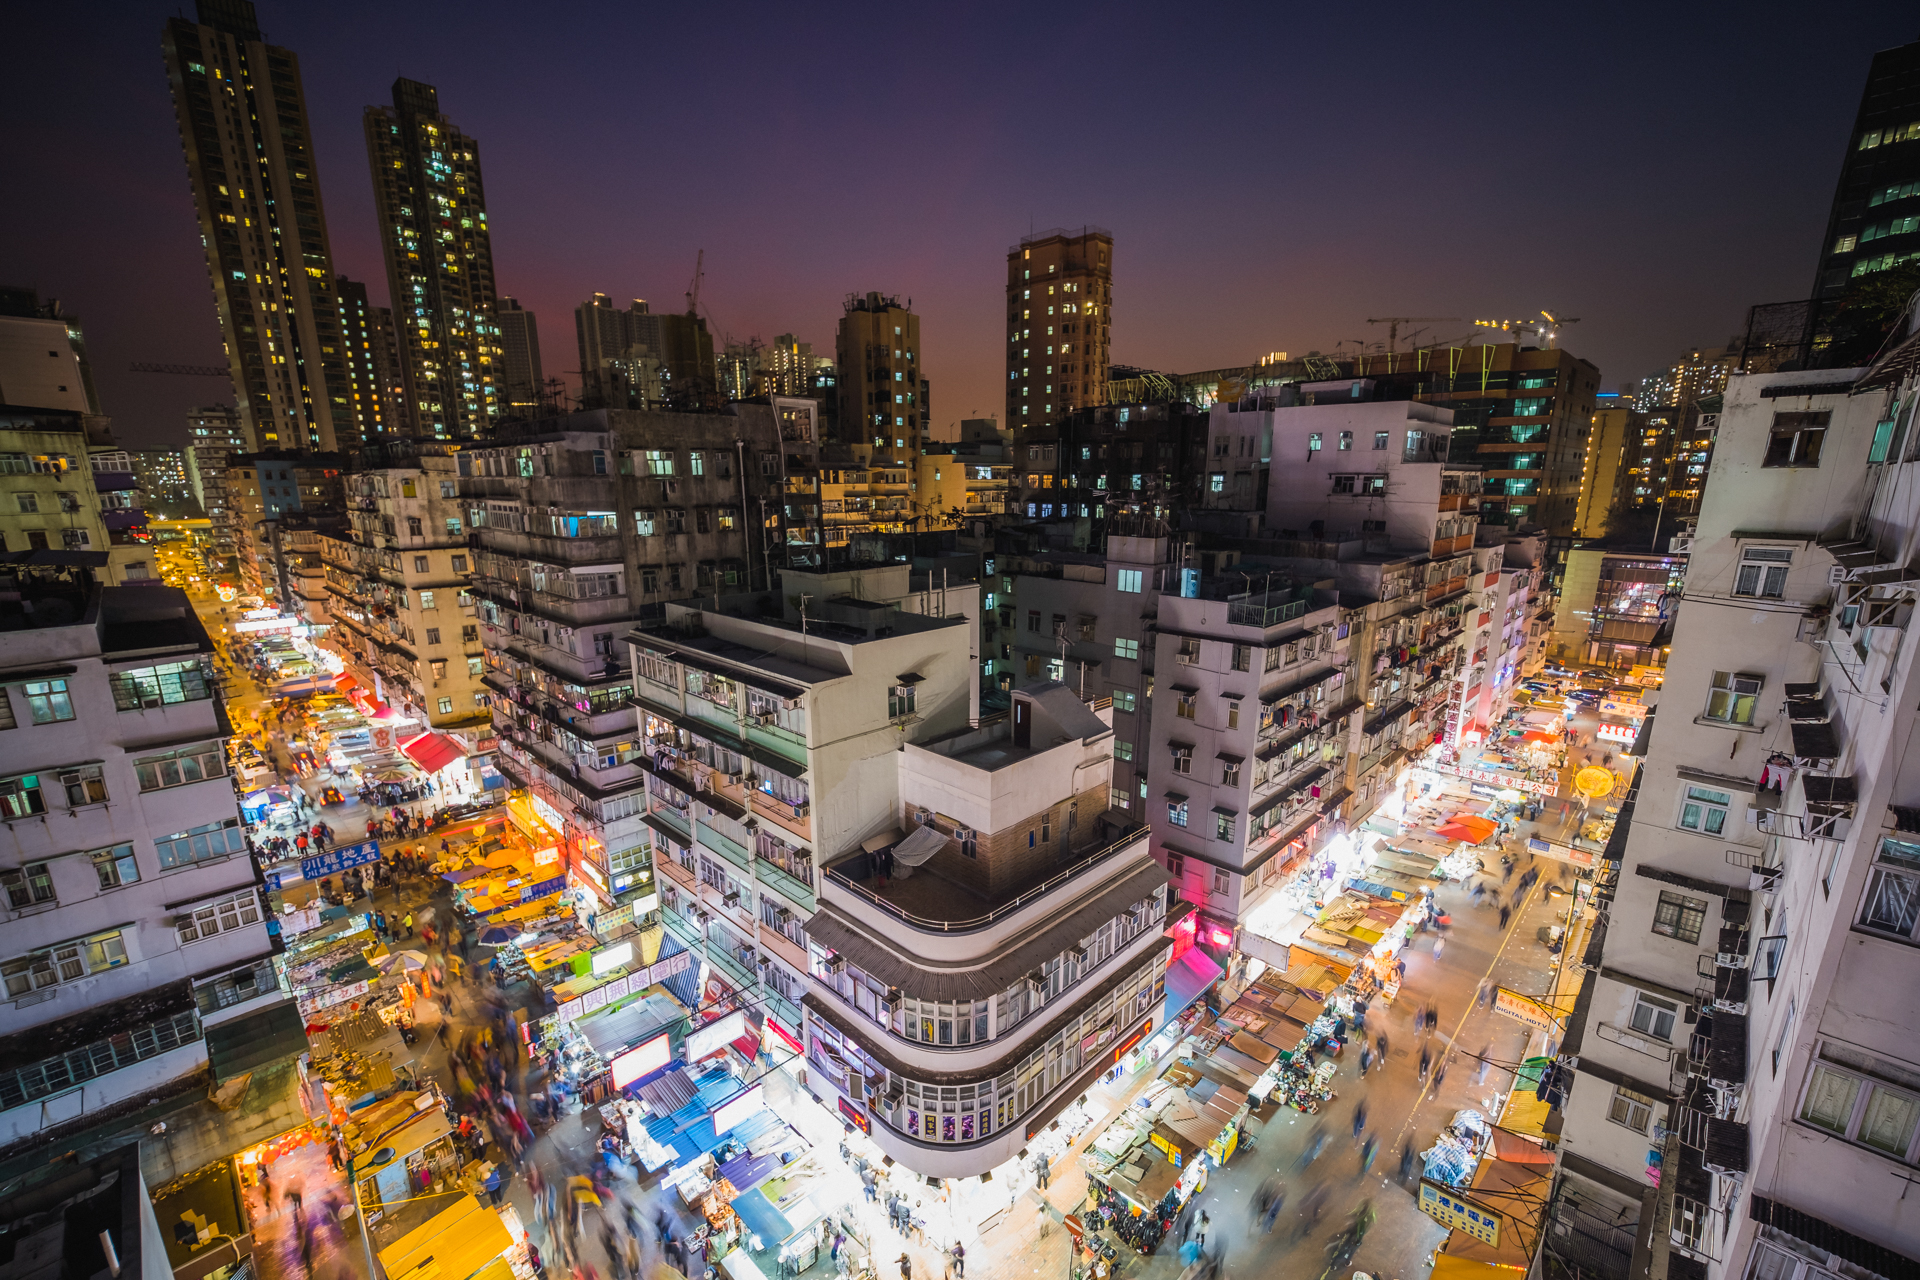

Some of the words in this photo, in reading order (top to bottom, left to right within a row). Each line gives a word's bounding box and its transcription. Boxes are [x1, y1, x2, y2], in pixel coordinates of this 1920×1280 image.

[306, 843, 376, 871] 川龍地產
[561, 953, 690, 1021] 和興無線電行
[1496, 1005, 1523, 1020] DIGITAL
[1526, 1017, 1548, 1029] HDTV
